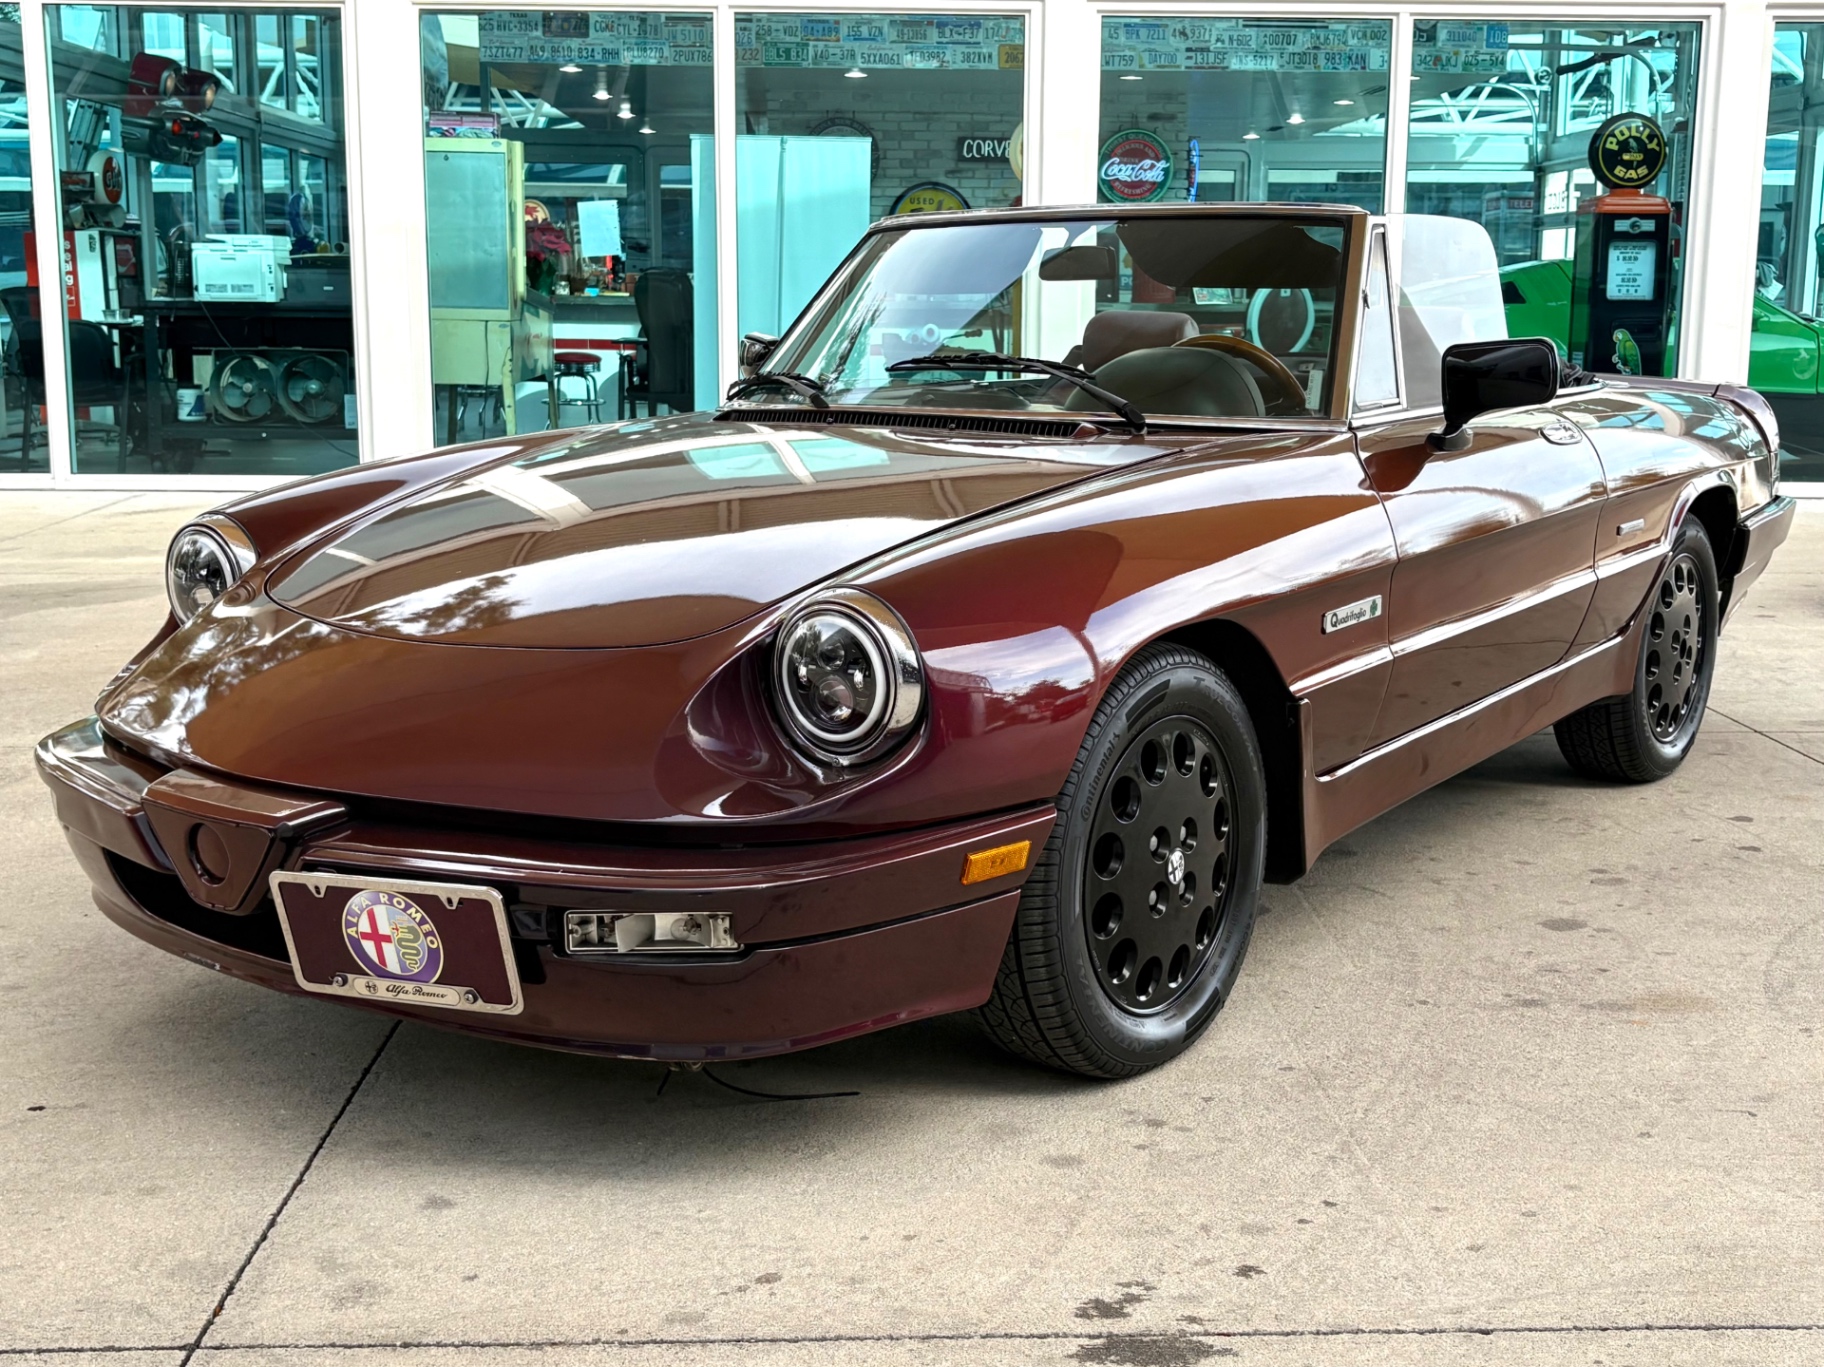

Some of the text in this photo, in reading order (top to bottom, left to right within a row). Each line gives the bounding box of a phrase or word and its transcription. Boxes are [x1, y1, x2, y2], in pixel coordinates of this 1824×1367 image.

[1605, 123, 1660, 152] POLLY
[1613, 165, 1649, 179] GAS
[909, 197, 935, 205] USED
[1330, 608, 1367, 628] Quadrifoglio
[346, 892, 438, 949] ALFA ROMEO
